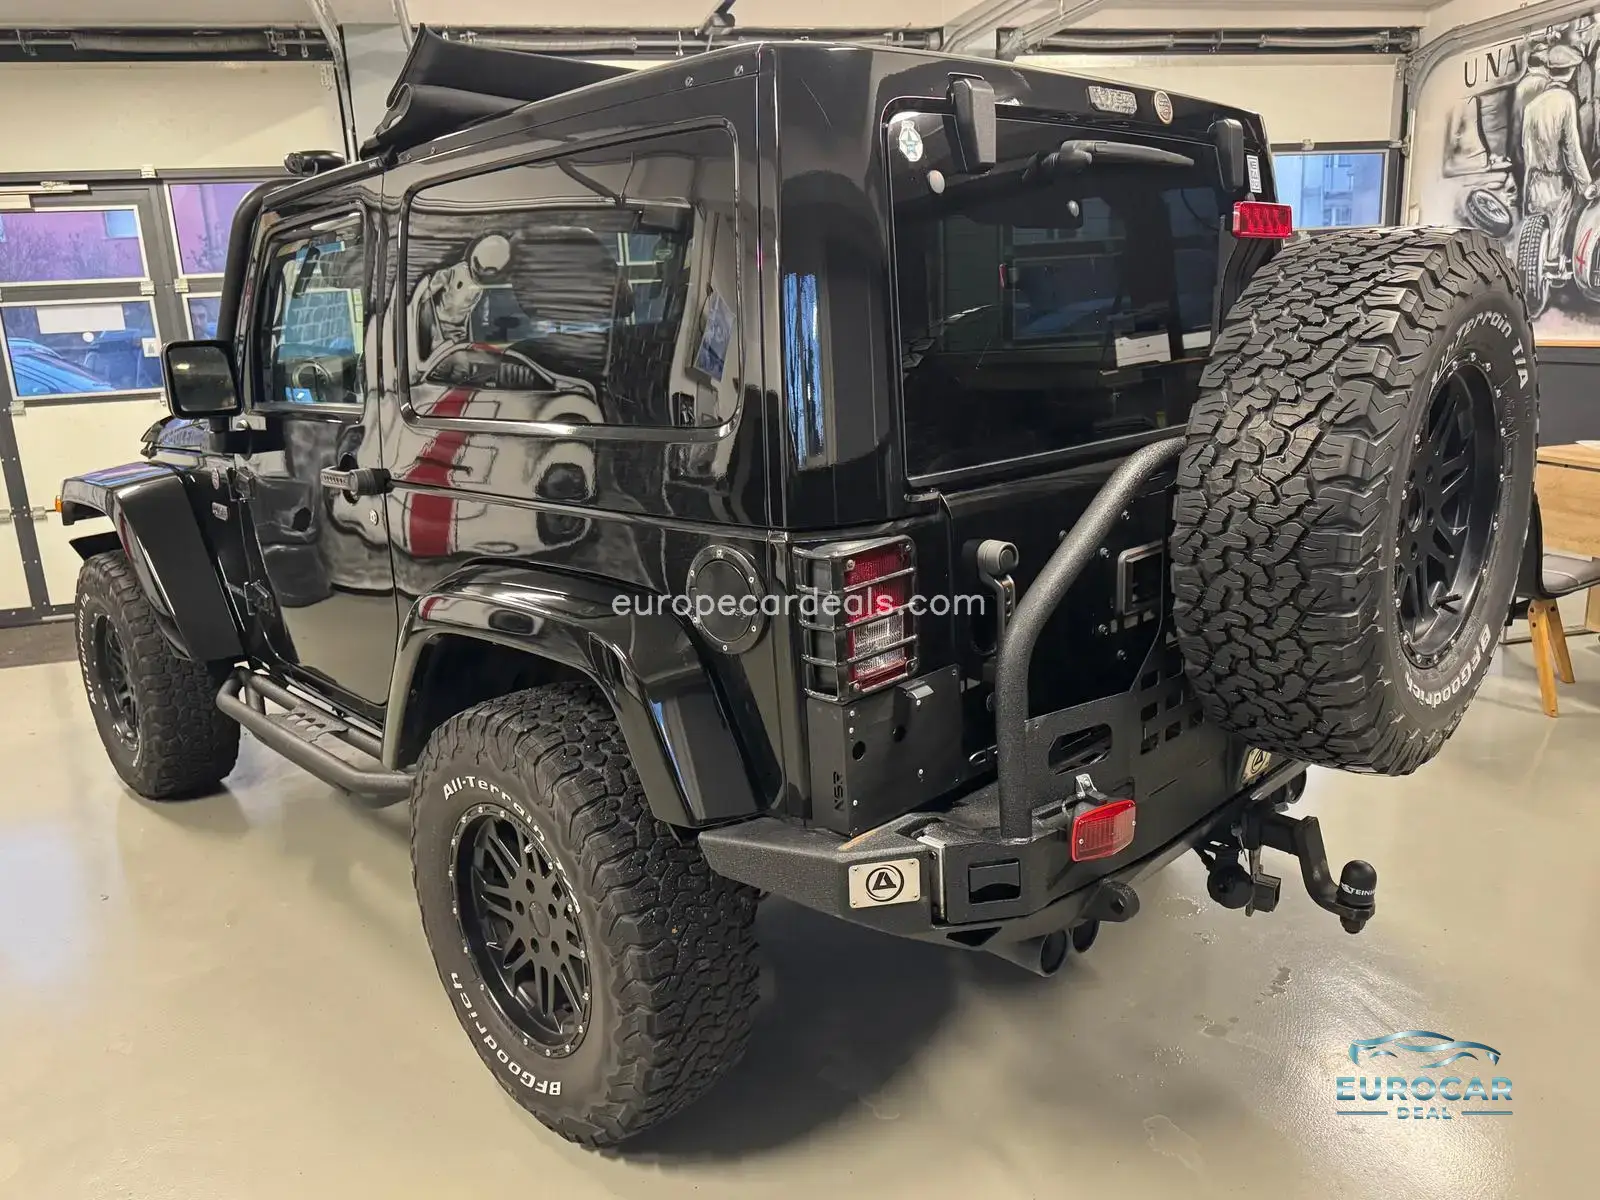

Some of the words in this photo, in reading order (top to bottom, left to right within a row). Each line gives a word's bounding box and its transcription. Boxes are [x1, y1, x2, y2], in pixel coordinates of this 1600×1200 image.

[1463, 44, 1521, 89] UNA
[1405, 623, 1491, 709] BFGoodrich
[442, 775, 546, 842] All-Terrain
[451, 972, 561, 1096] BFGoodrich
